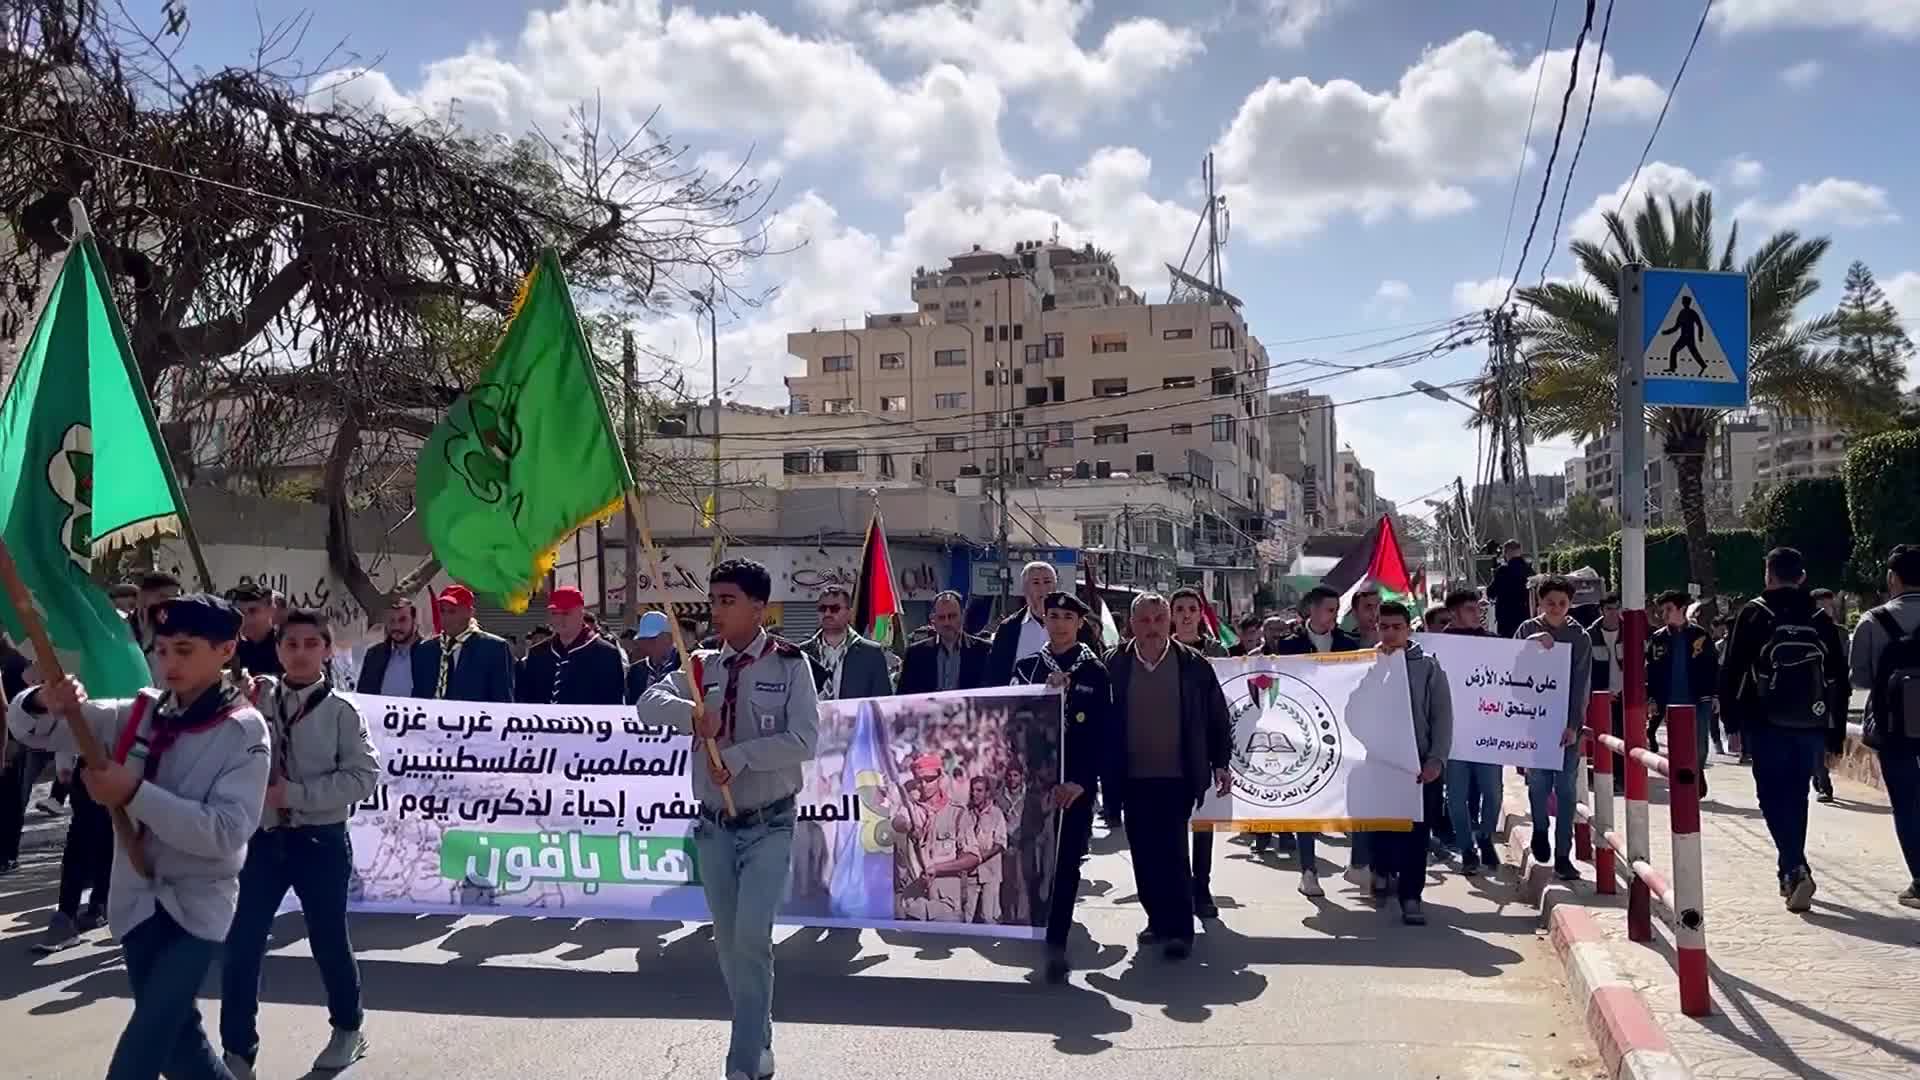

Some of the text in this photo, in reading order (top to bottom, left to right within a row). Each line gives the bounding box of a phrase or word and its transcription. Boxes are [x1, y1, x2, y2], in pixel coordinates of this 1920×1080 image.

[1465, 665, 1498, 688] الأرض
[1536, 674, 1557, 693] على
[383, 704, 427, 738] غزة
[437, 710, 493, 740] غرب
[1505, 701, 1537, 720] يستحق
[1538, 704, 1547, 717] ما
[501, 713, 613, 743] والتعليم
[387, 745, 688, 783] المعلمين الفلسطينيين
[399, 793, 449, 821] يوم
[458, 787, 552, 824] لذكرى
[464, 831, 692, 895] هنا باقون
